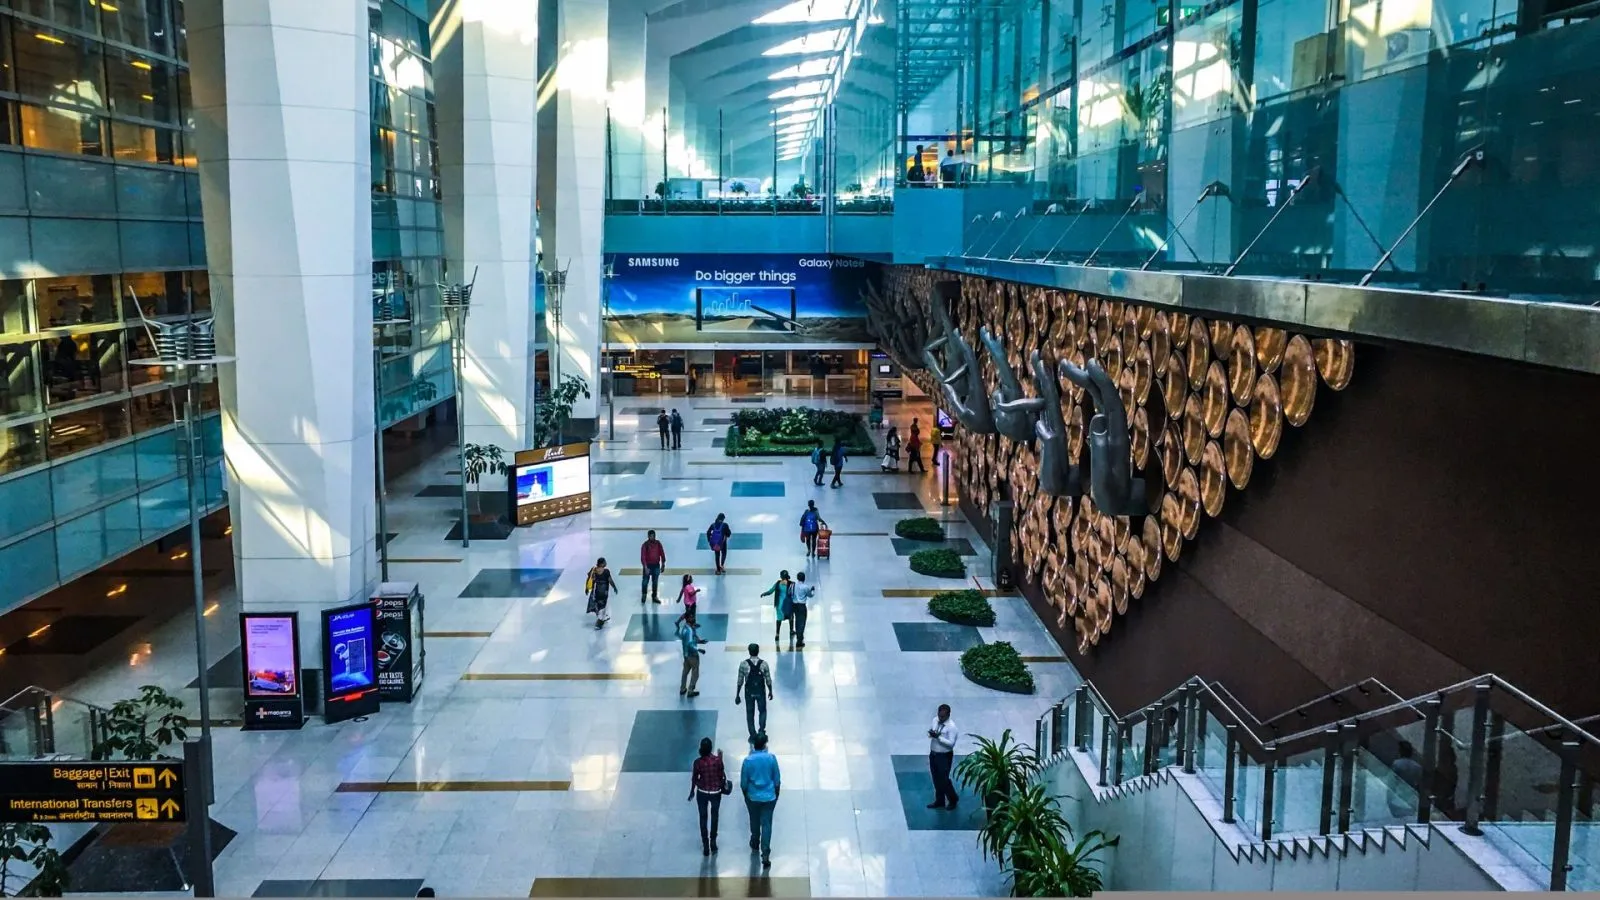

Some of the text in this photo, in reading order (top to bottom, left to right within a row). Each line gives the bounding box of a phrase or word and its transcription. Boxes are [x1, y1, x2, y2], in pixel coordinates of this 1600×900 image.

[628, 257, 680, 267] SAMSUNG
[798, 258, 835, 270] Galaxy
[695, 270, 797, 285] Do bigger things
[383, 611, 404, 619] pepsi
[53, 767, 103, 781] Baggage
[109, 768, 131, 779] Exit
[76, 781, 98, 790] सामान
[109, 781, 132, 790] निकास
[10, 798, 133, 809] International Transfers
